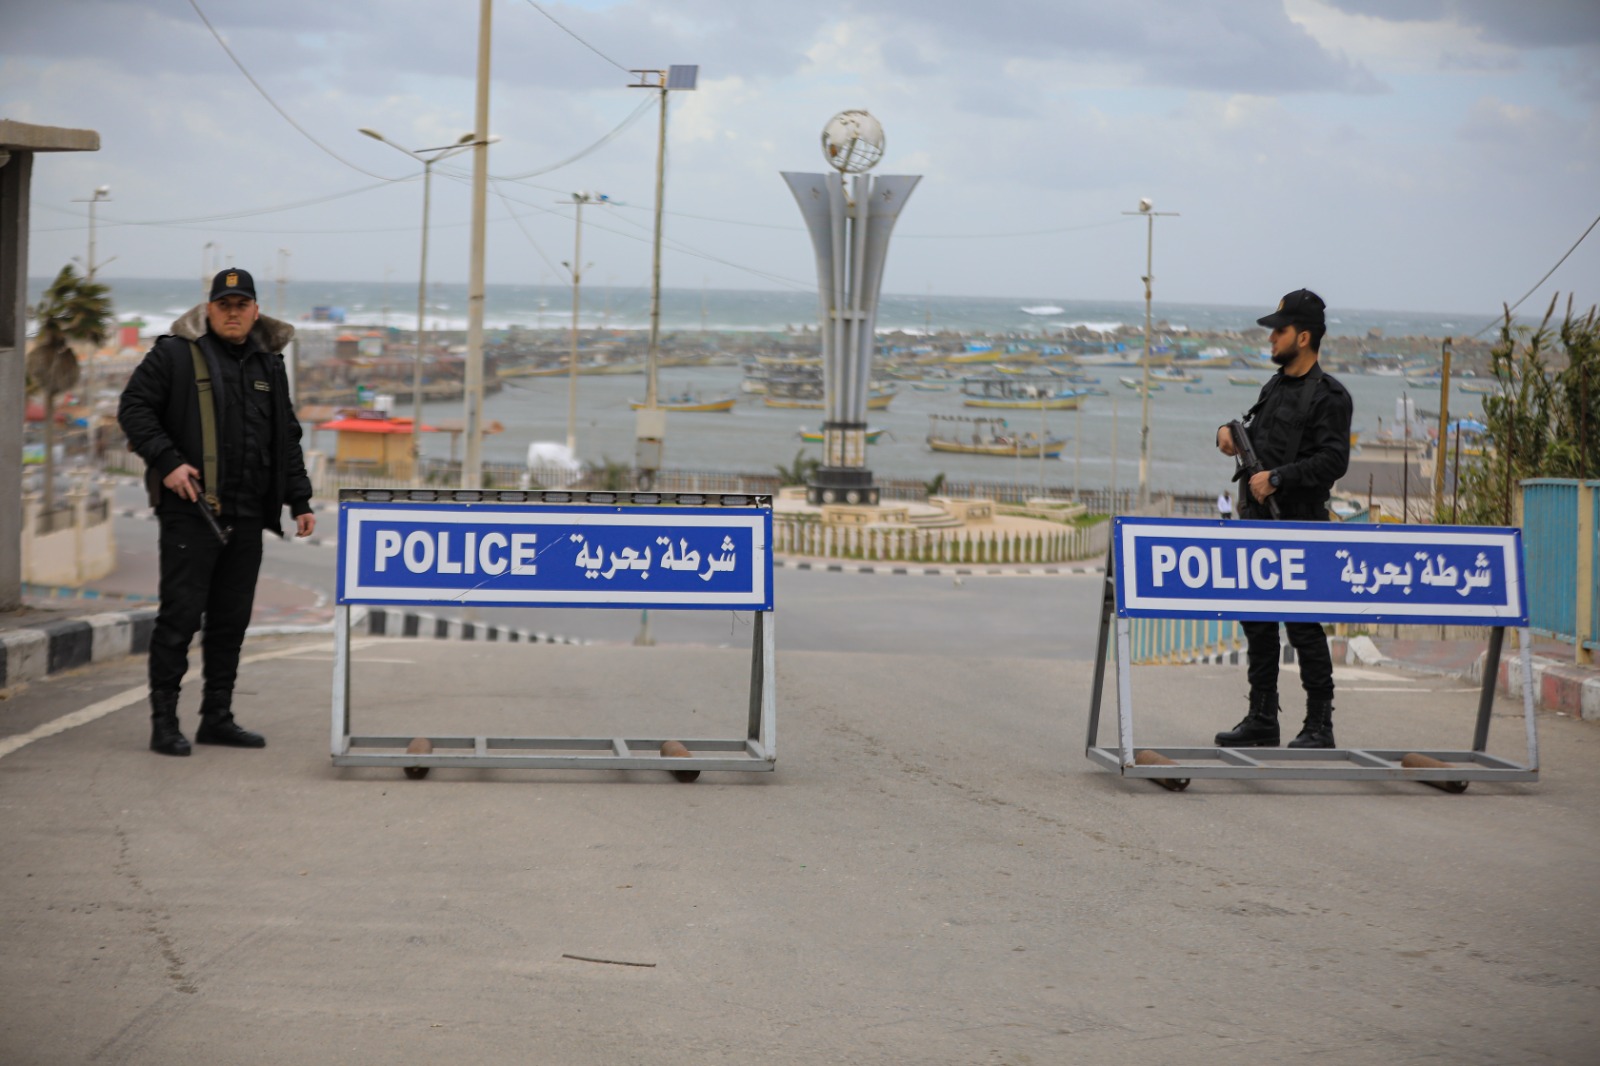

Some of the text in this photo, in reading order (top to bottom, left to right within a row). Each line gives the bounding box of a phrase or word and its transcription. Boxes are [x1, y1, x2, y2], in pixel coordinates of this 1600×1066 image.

[374, 530, 537, 576] POLICE
[569, 534, 736, 581] شرطة بحرية
[1151, 545, 1308, 591] POLICE
[1335, 549, 1491, 597] شرطة بحرية
